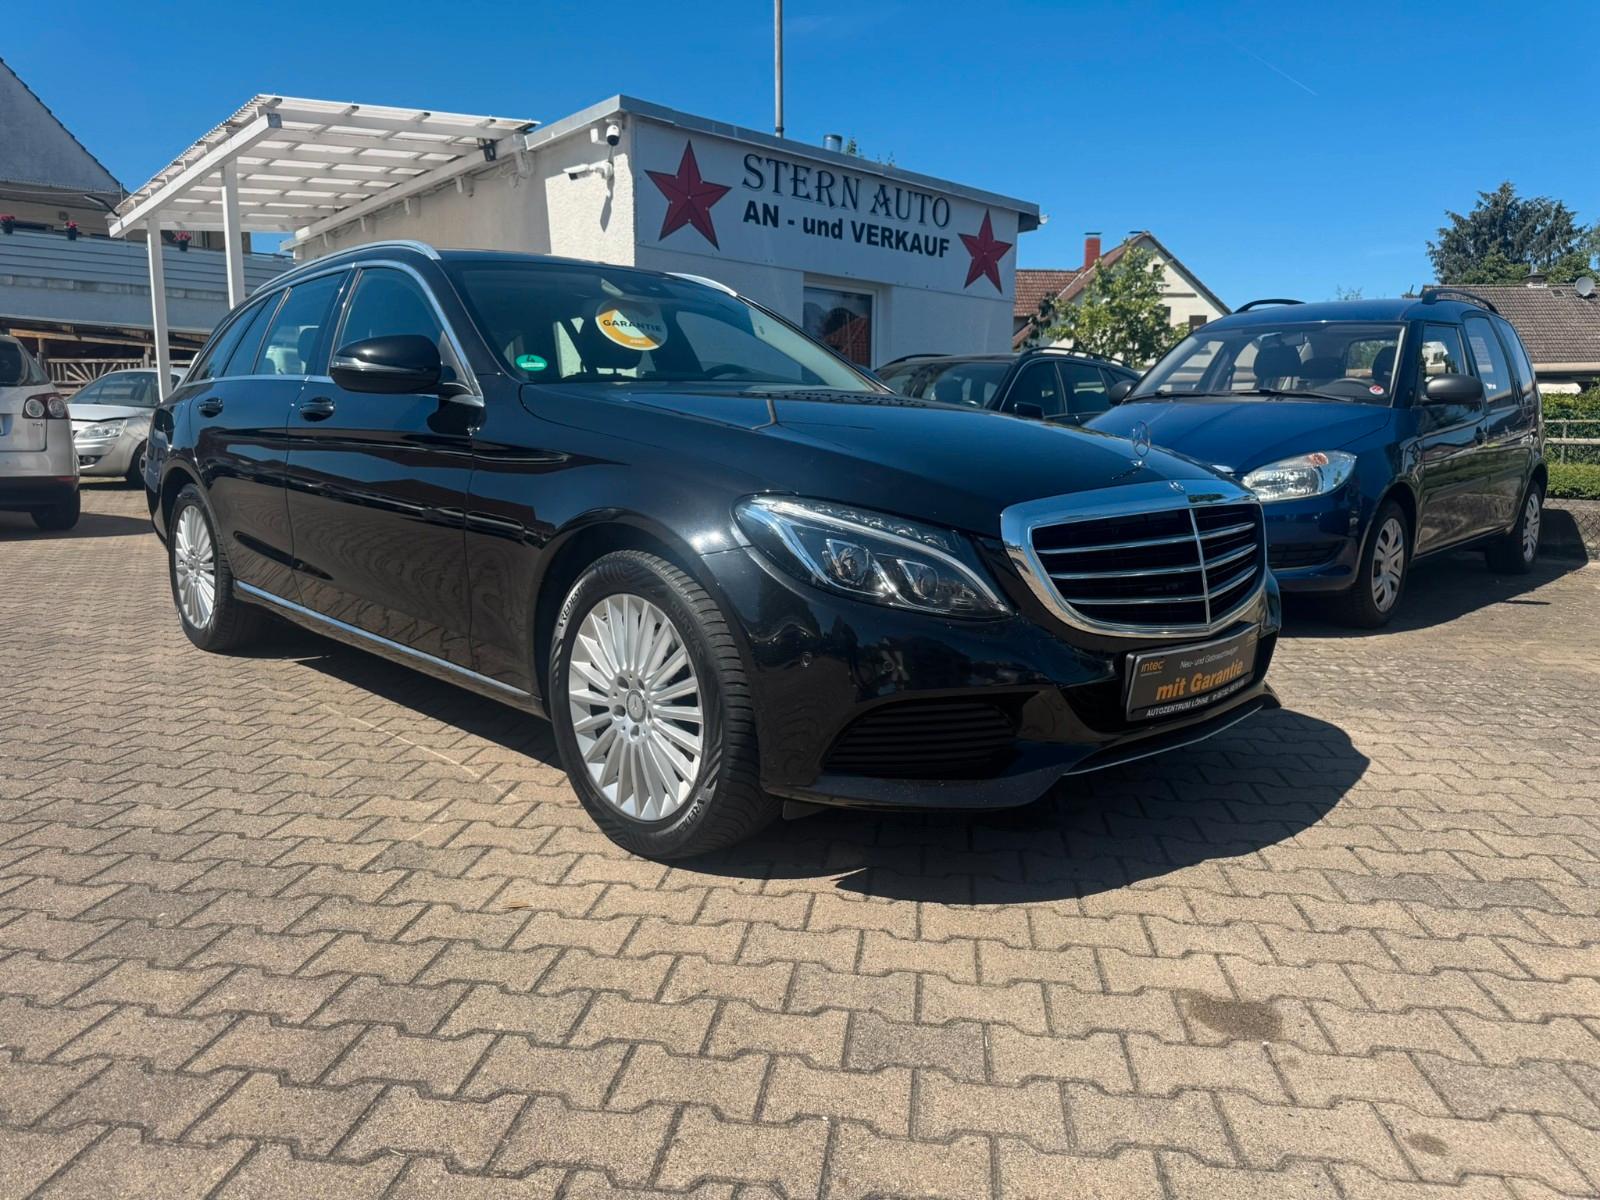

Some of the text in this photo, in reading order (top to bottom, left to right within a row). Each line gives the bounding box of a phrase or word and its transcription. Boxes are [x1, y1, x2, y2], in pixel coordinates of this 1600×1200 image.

[742, 153, 950, 229] STERN AUTO
[743, 200, 779, 228] AN
[803, 217, 843, 240] und
[852, 221, 950, 258] VERKAUF
[602, 319, 663, 331] GARANTIE
[1141, 660, 1165, 673] intec
[1156, 677, 1186, 700] mit
[1190, 659, 1244, 693] Garantie
[1146, 699, 1191, 718] AUTOZENTRUM
